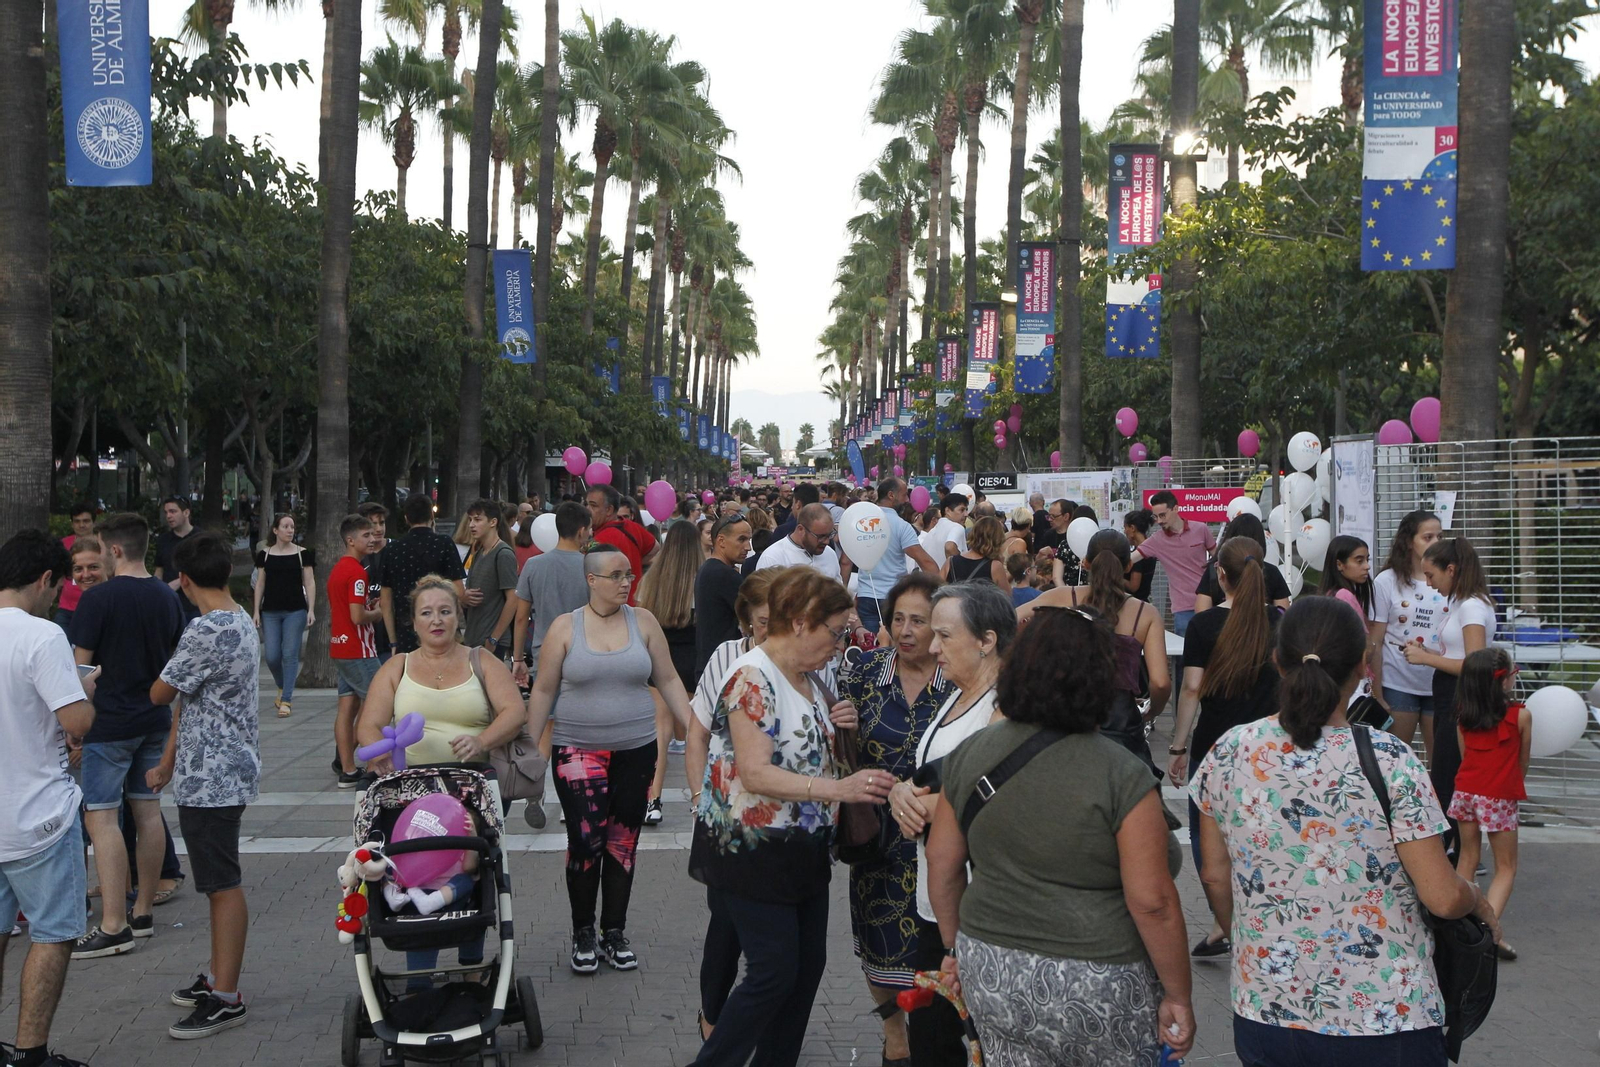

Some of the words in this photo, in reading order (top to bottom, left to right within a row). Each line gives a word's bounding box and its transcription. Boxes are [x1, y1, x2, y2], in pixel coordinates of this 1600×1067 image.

[1386, 50, 1399, 72] LA
[108, 58, 124, 85] DE
[1384, 92, 1419, 100] CIENCIA
[1421, 92, 1431, 100] de
[1382, 101, 1442, 110] UNIVERSIDAD
[1392, 111, 1421, 119] TODOS
[1439, 135, 1454, 146] 30
[1134, 157, 1143, 177] L@S
[1133, 180, 1142, 192] DE
[1144, 157, 1154, 242] INVESTIGADOR@S
[1121, 189, 1130, 224] NOCHE
[1132, 196, 1142, 242] EUROPEA
[1121, 230, 1129, 242] LA
[1034, 267, 1040, 278] DE
[506, 270, 515, 322] UNIVERSIDAD
[1025, 302, 1032, 312] LA
[515, 312, 522, 322] DE
[978, 477, 1012, 486] CIESOL
